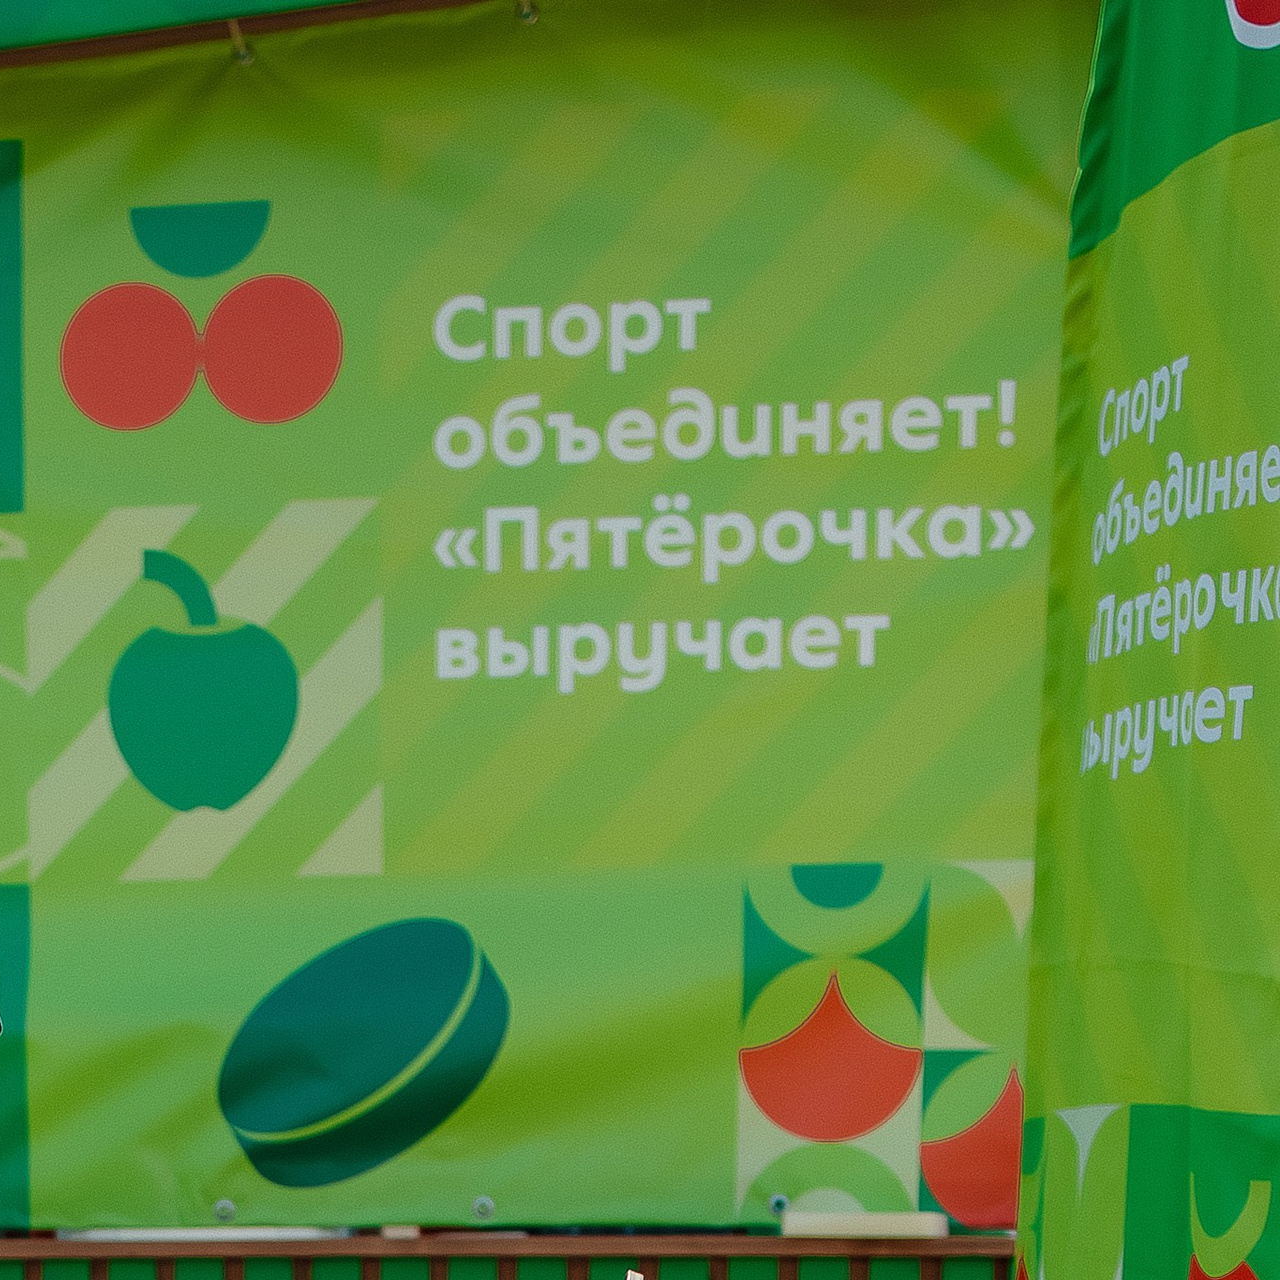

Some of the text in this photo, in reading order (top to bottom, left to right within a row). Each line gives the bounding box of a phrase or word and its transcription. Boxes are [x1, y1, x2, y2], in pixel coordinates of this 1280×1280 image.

[433, 294, 712, 372] Спорт
[433, 379, 1017, 470] объединяет!
[1098, 354, 1190, 457] Спорт
[434, 493, 1036, 584] «Пятёрочка»
[435, 614, 891, 694] выручает
[1087, 563, 1280, 665] Пятёрочк
[1080, 684, 1255, 781] ыручает
